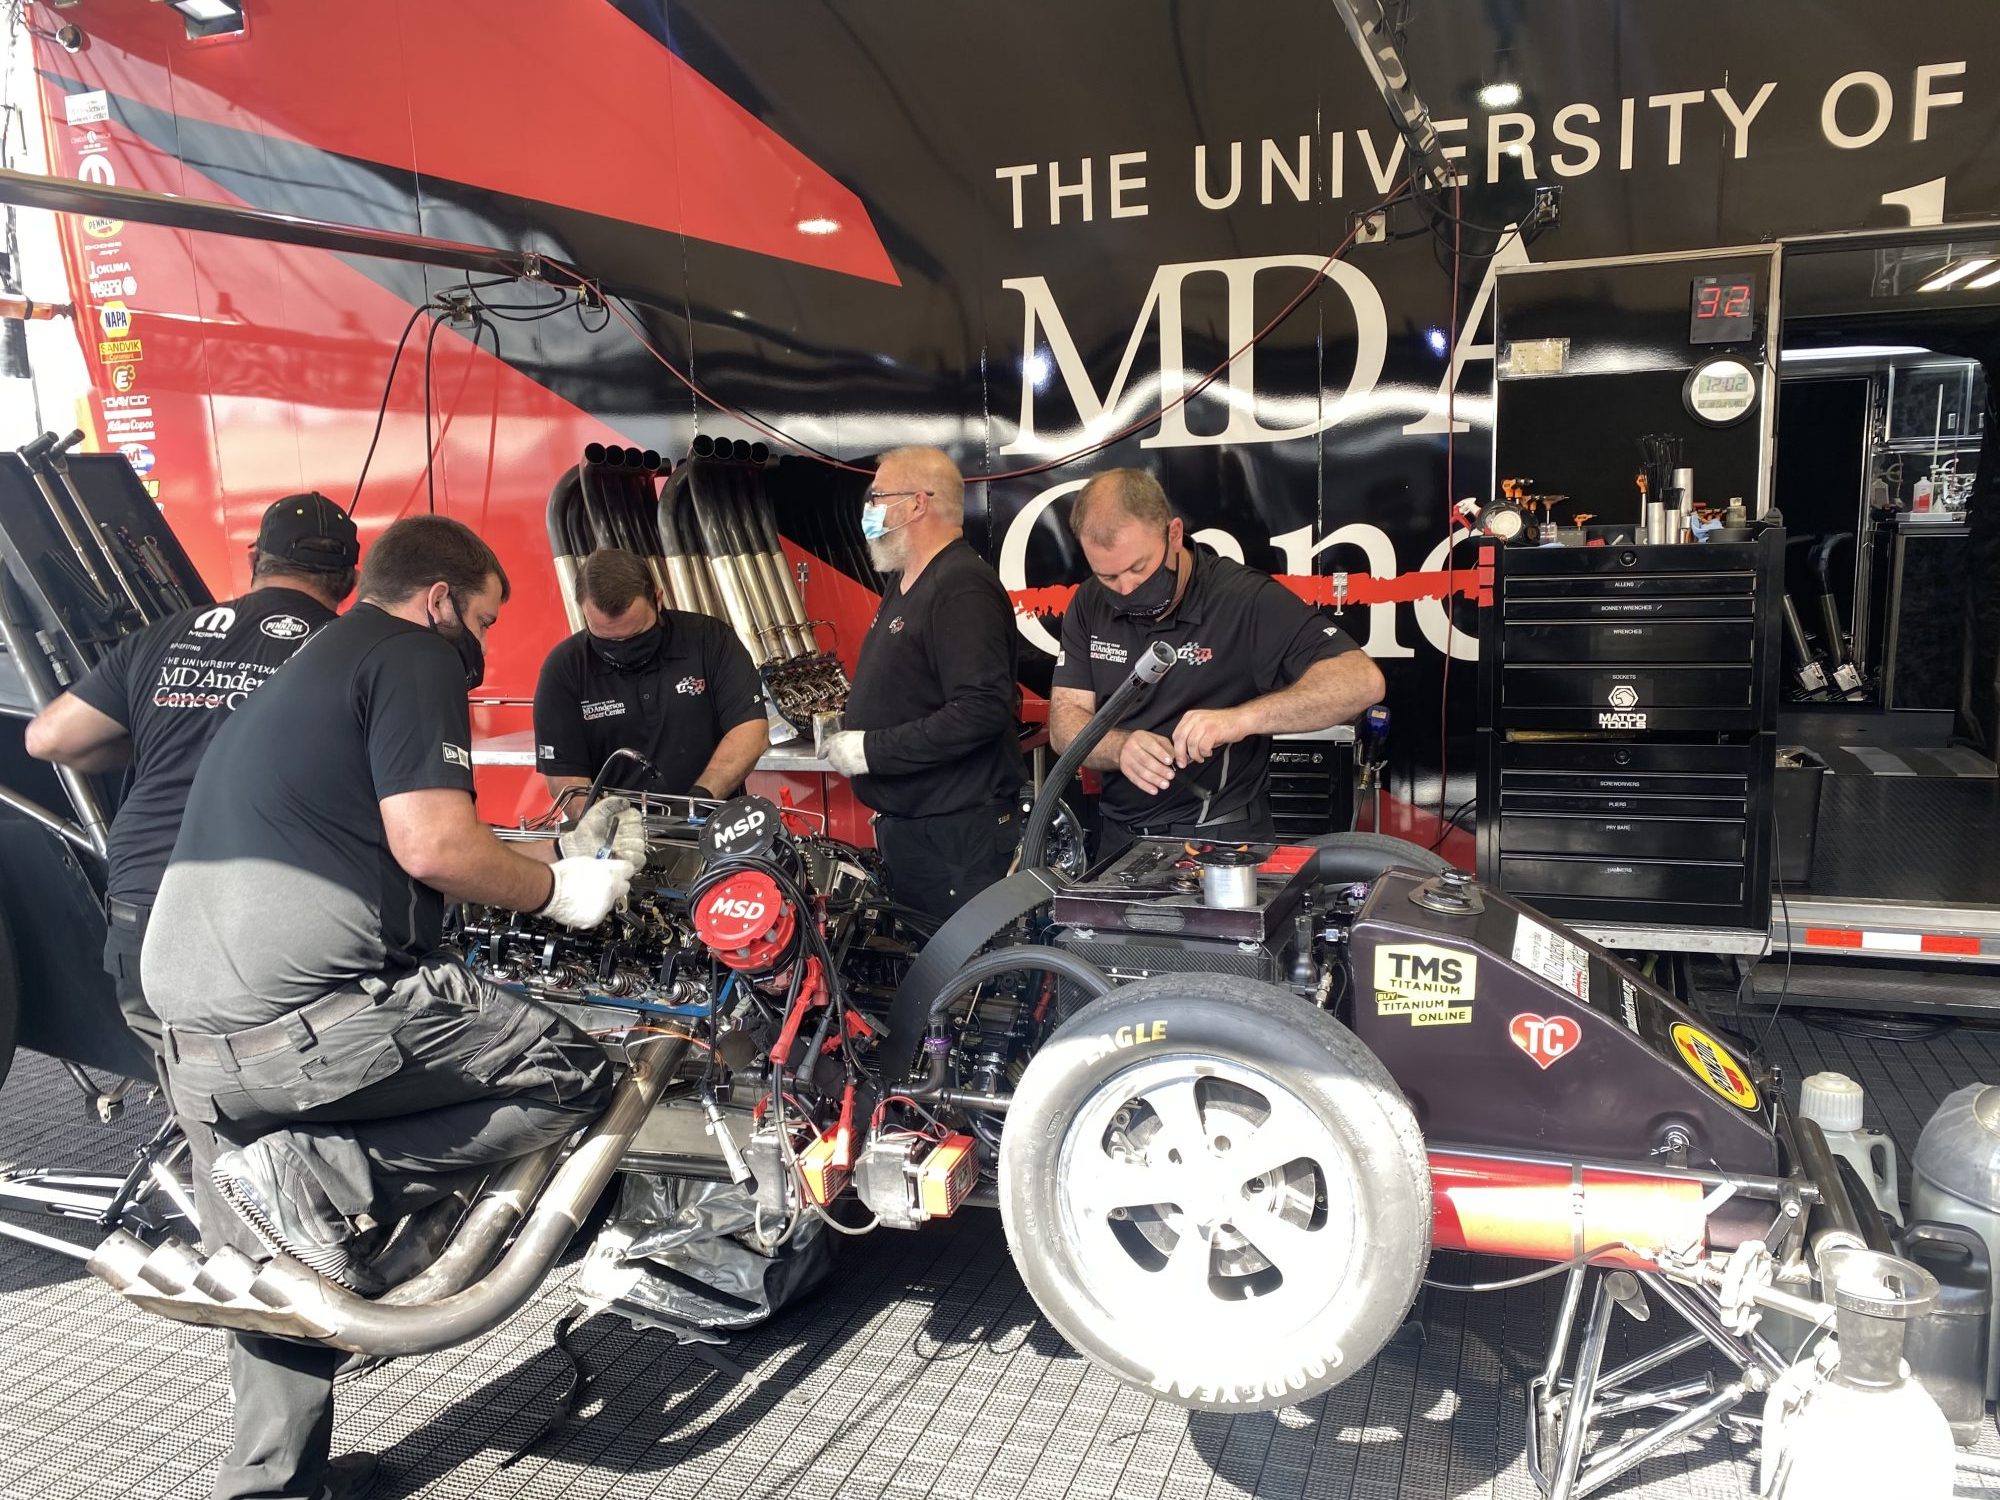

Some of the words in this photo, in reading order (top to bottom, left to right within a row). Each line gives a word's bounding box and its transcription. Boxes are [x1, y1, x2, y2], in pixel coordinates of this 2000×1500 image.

[995, 151, 1149, 229] THE
[1195, 81, 1778, 210] UNIVERSITY
[1820, 61, 1967, 149] OF
[1696, 285, 1751, 319] 32
[104, 311, 128, 328] NAPA
[100, 341, 141, 353] SANDVIK
[1000, 254, 1388, 456] MD
[1702, 374, 1749, 394] 12:02
[106, 395, 148, 408] DAYCO
[265, 621, 304, 634] PENNZOIL
[1098, 644, 1128, 657] Anderson
[164, 657, 179, 665] THE
[182, 660, 236, 669] UNIVERSITY
[238, 662, 252, 671] OF
[253, 663, 279, 675] TEXA
[1105, 654, 1128, 664] Center
[157, 666, 200, 687] MD
[153, 687, 225, 709] Cancer
[593, 702, 625, 713] Anderson
[604, 708, 627, 717] Center
[1599, 713, 1647, 722] MATCO
[1601, 721, 1647, 730] TOOLS
[714, 810, 766, 849] MSD
[708, 897, 765, 920] MSD
[1388, 952, 1463, 985] TMS
[1390, 979, 1461, 995] TITANIUM
[1377, 992, 1397, 1001] BUY
[1383, 1000, 1445, 1011] TITANIUM
[1418, 1011, 1467, 1022] ONLINE
[1524, 1020, 1566, 1057] TC
